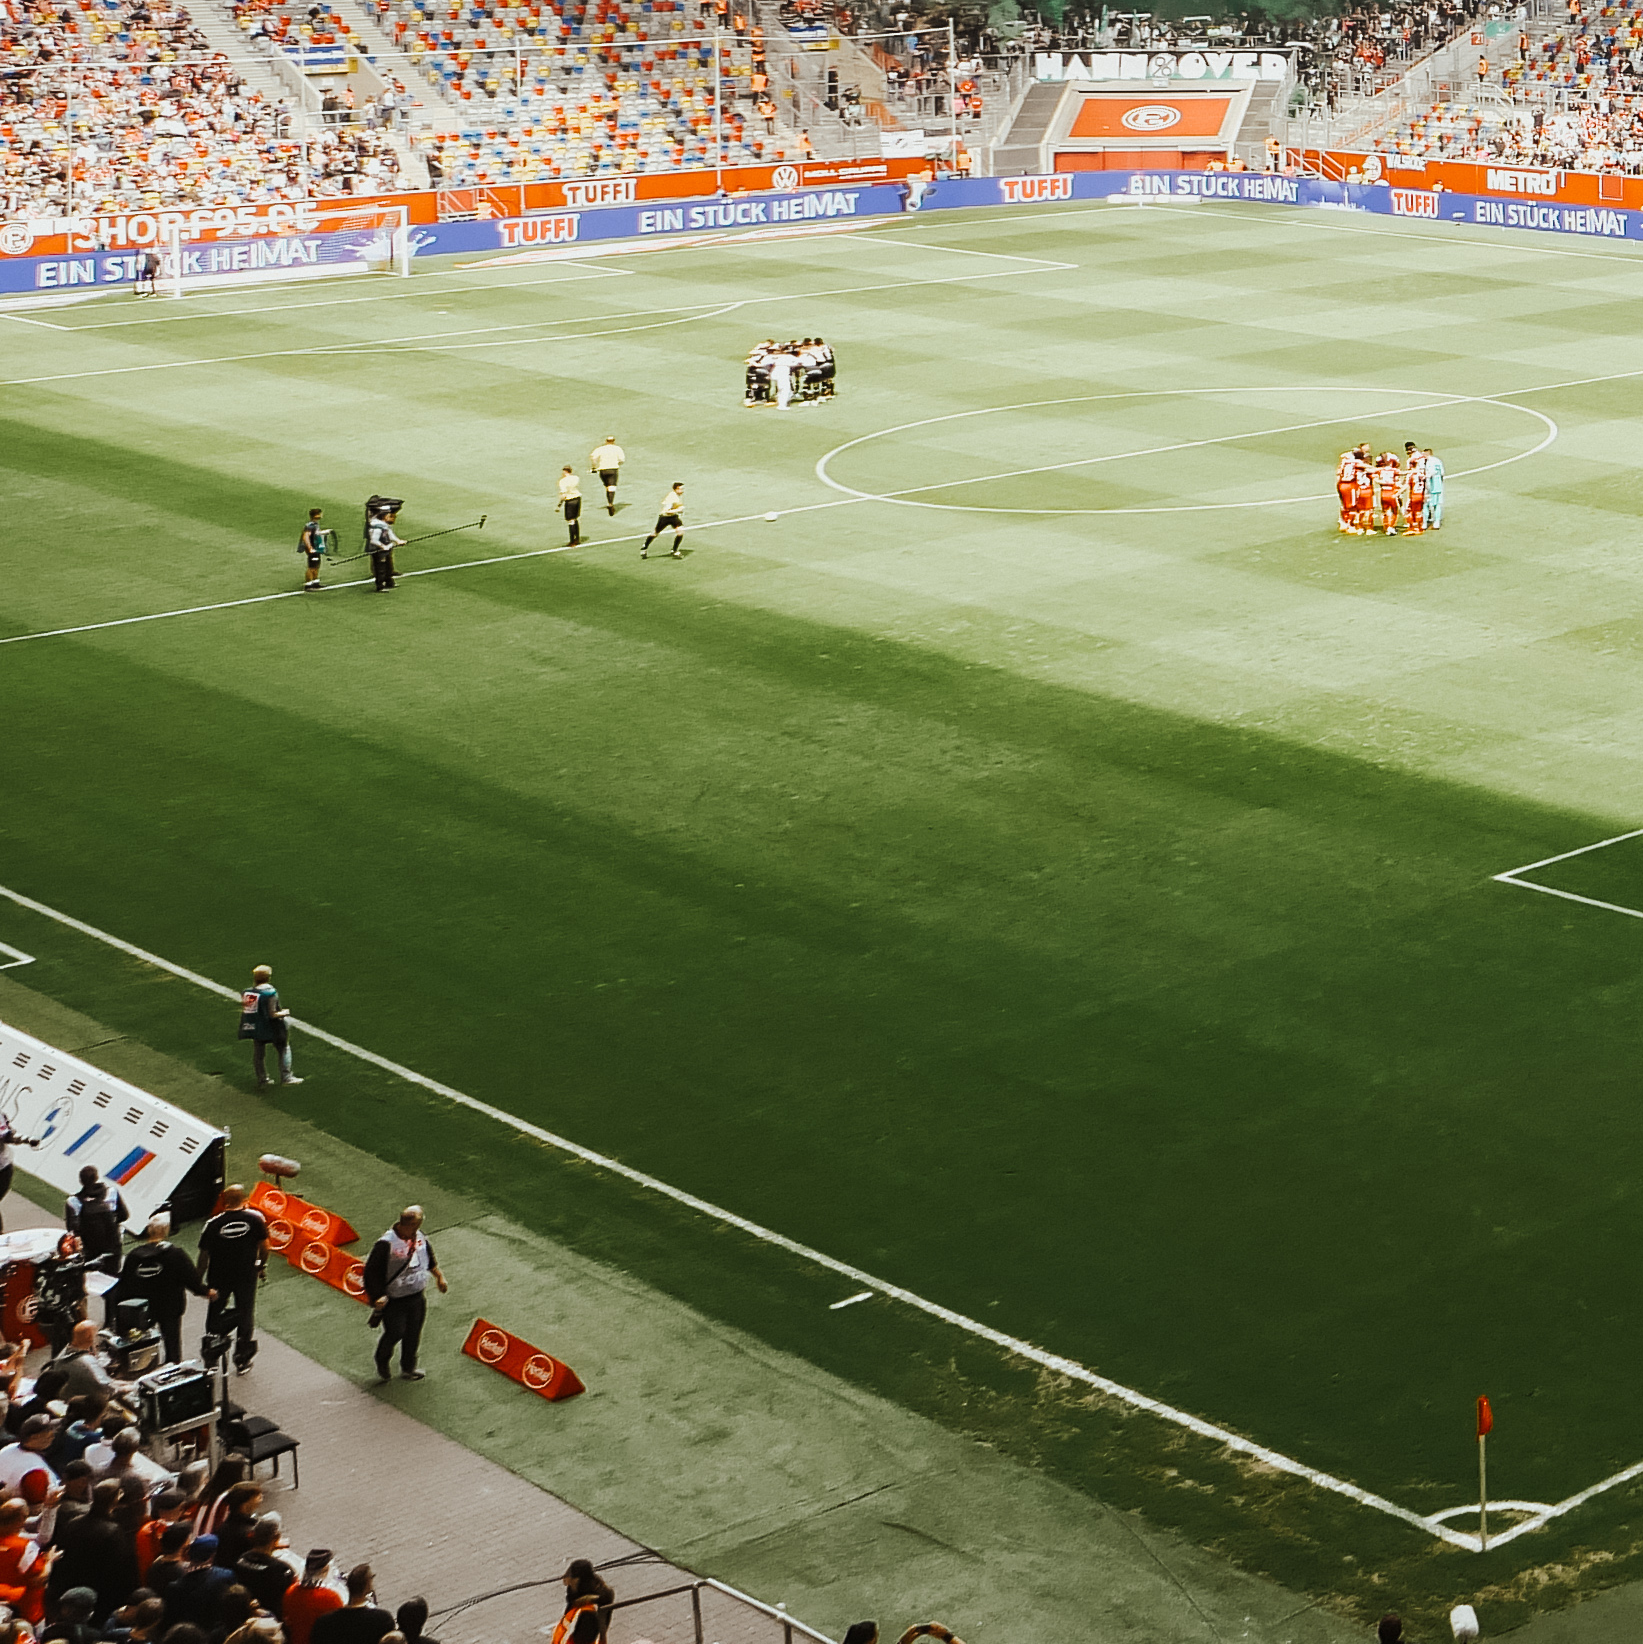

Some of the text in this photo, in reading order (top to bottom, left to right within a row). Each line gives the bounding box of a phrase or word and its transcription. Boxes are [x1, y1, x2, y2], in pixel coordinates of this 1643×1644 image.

[562, 178, 636, 207] TUFFI
[1001, 174, 1074, 203] TUFFI
[1177, 170, 1240, 197] STÜCK
[1243, 177, 1300, 203] HEIMAT
[1486, 169, 1557, 196] METRO
[640, 191, 860, 234] EIN STÜCK HEIMAT
[1390, 188, 1440, 218] TUFFI
[1475, 200, 1629, 237] EIN STÜCK HEIMAT
[498, 213, 582, 248] TUFFI
[36, 239, 323, 288] EIN STCK HEIMAT
